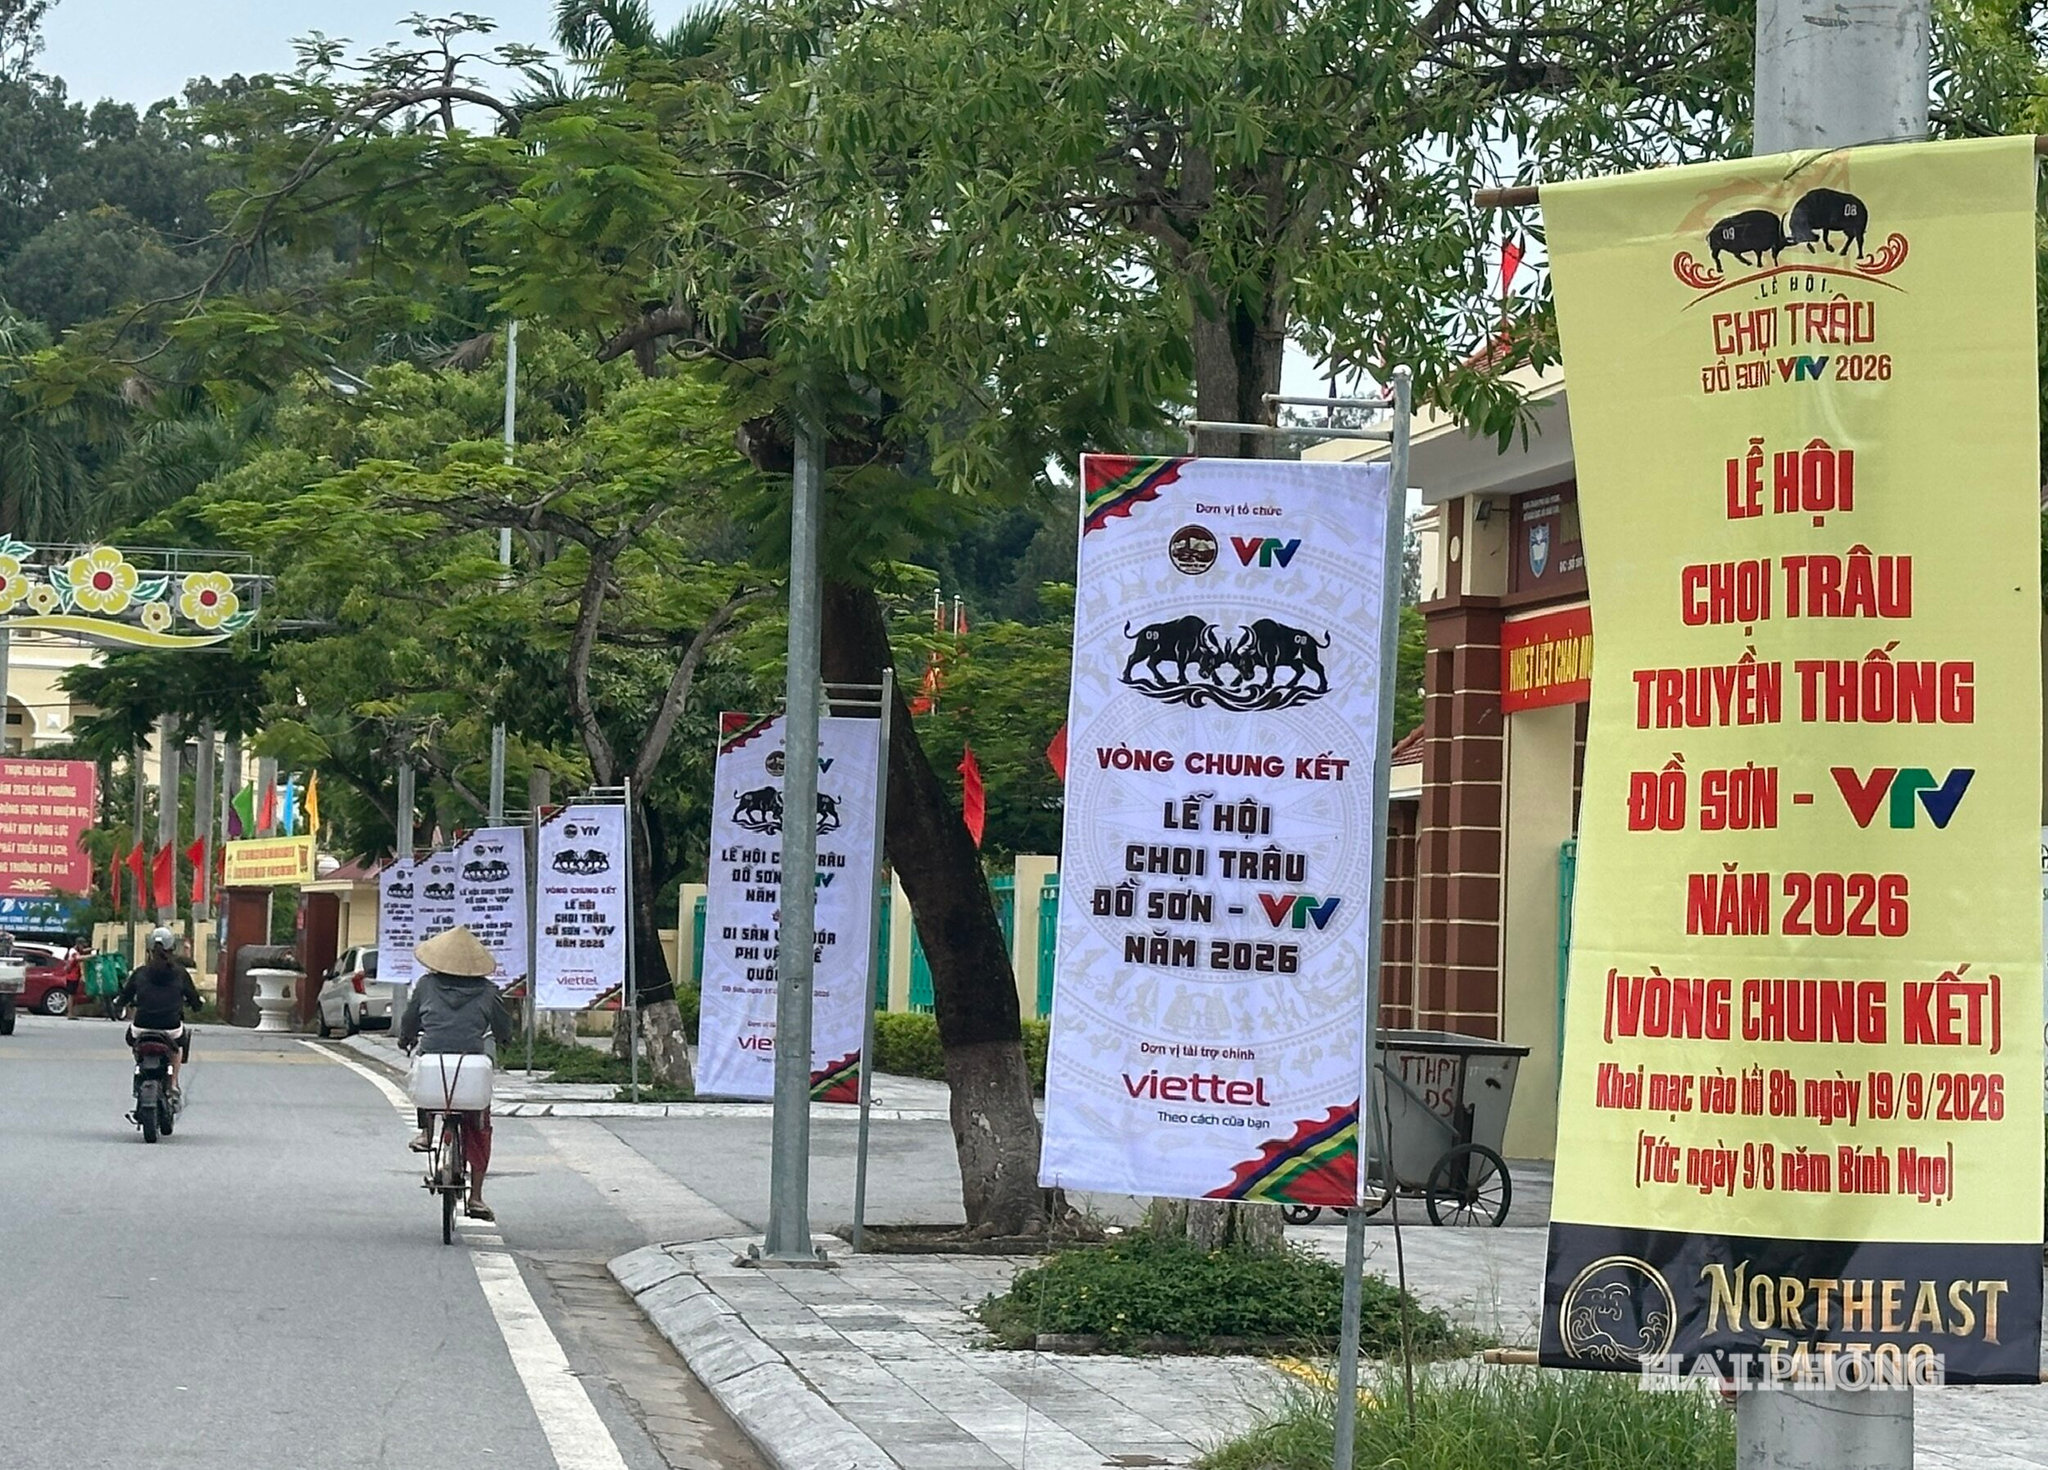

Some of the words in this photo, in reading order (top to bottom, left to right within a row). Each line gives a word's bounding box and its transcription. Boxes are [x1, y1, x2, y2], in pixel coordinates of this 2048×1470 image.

[1844, 204, 1857, 216] 08
[1722, 227, 1735, 240] 09
[1713, 306, 1777, 357] CHỌI
[1784, 294, 1875, 346] TRÂU
[1835, 354, 1892, 381] 2026
[1726, 437, 1765, 520] LỄ
[1774, 437, 1854, 528] HỘI
[1196, 503, 1220, 514] Đơn
[1224, 504, 1235, 517] vị
[1252, 505, 1282, 517] chức
[1230, 536, 1302, 568] VTV
[1681, 557, 1772, 637] CHỌI
[1781, 543, 1913, 619] TRÂU
[1146, 631, 1159, 640] 09
[1633, 644, 1783, 730] TRUYỀN
[1794, 640, 1975, 724] THỐNG
[1096, 742, 1174, 773] VÒNG
[1185, 752, 1285, 778] CHUNG
[1295, 750, 1350, 781] KẾT
[1627, 752, 1688, 832] ĐỒ
[1700, 761, 1779, 832] SƠN
[1829, 767, 1976, 830] VTV
[1163, 791, 1214, 831] LỄ
[1213, 797, 1270, 840] HỘI
[722, 845, 743, 862] LỄ
[742, 848, 766, 865] HỘI
[815, 851, 846, 868] RÂU
[1125, 844, 1205, 881] CHỌI
[1218, 844, 1306, 883] TRÂU
[746, 887, 776, 903] NĂM
[1090, 878, 1140, 917] ĐỒ
[1147, 889, 1212, 923] SƠN
[1258, 893, 1341, 931] VTV
[1686, 862, 1771, 937] NĂM
[1781, 871, 1910, 938] 2026
[723, 927, 737, 940] DI
[741, 924, 769, 941] SẢN
[813, 928, 836, 945] ÓA
[735, 947, 759, 960] PHI
[1124, 930, 1197, 968] NĂM
[1210, 941, 1299, 974] 2026
[556, 976, 599, 985] viettel
[747, 966, 778, 982] QUỐ
[1741, 979, 1888, 1045] CHUNG
[1141, 1042, 1166, 1055] Đơn
[1169, 1044, 1180, 1058] vị
[1183, 1044, 1198, 1057] tài
[1201, 1046, 1220, 1060] trợ
[1223, 1048, 1255, 1061] chính
[1122, 1069, 1271, 1107] viettel
[1401, 1056, 1459, 1086] TTHPT
[1596, 1062, 1645, 1110] Khai
[1648, 1073, 1695, 1123] mạc
[1700, 1067, 1737, 1114] vào
[1769, 1069, 1797, 1117] 8h
[1804, 1070, 1861, 1127] ngày
[1867, 1071, 2005, 1122] 19/9/2026
[1158, 1111, 1188, 1124] Theo
[1191, 1114, 1219, 1126] cách
[1222, 1115, 1245, 1127] của
[1247, 1117, 1270, 1131] bạn
[1686, 1139, 1738, 1196] ngày
[1743, 1142, 1775, 1191] 9/8
[1781, 1145, 1831, 1194] năm
[1700, 1259, 2010, 1346] NORTHEAST
